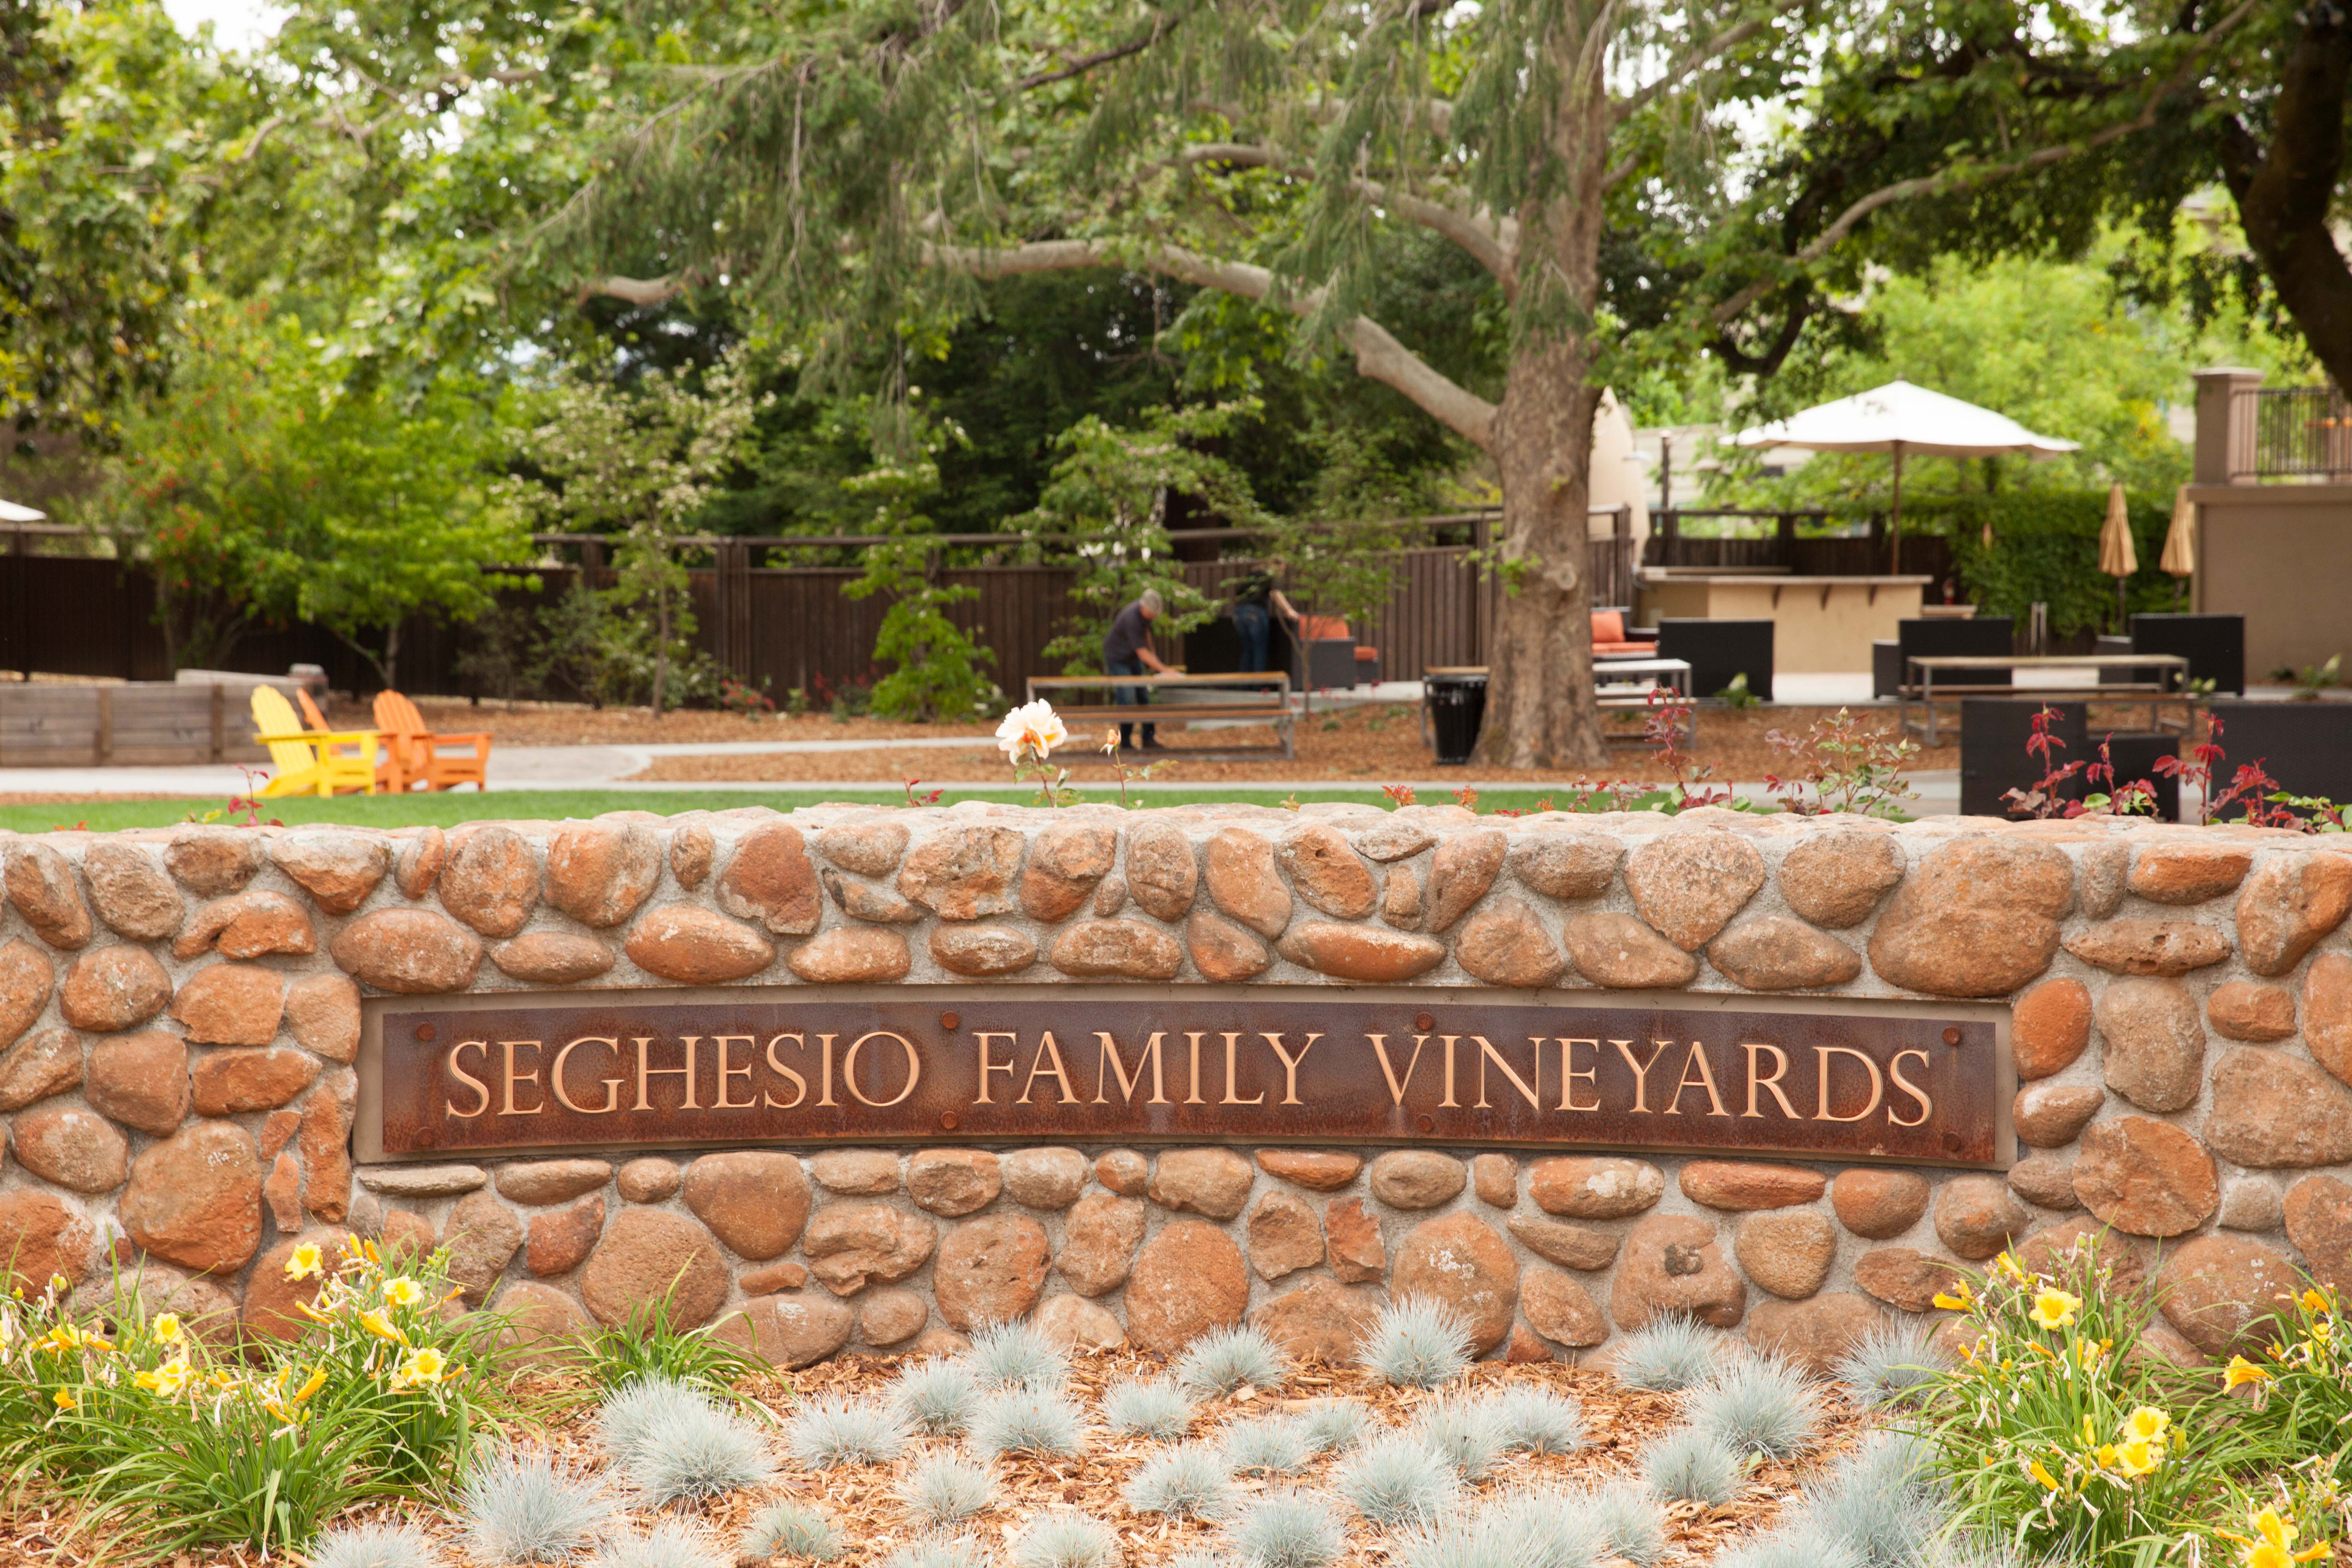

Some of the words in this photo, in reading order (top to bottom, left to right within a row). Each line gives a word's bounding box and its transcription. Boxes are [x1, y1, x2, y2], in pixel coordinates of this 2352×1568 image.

[445, 1031, 920, 1119] SEGHESIO
[972, 1030, 1325, 1105] FAMILY
[1364, 1033, 1933, 1127] VINEYARDS
